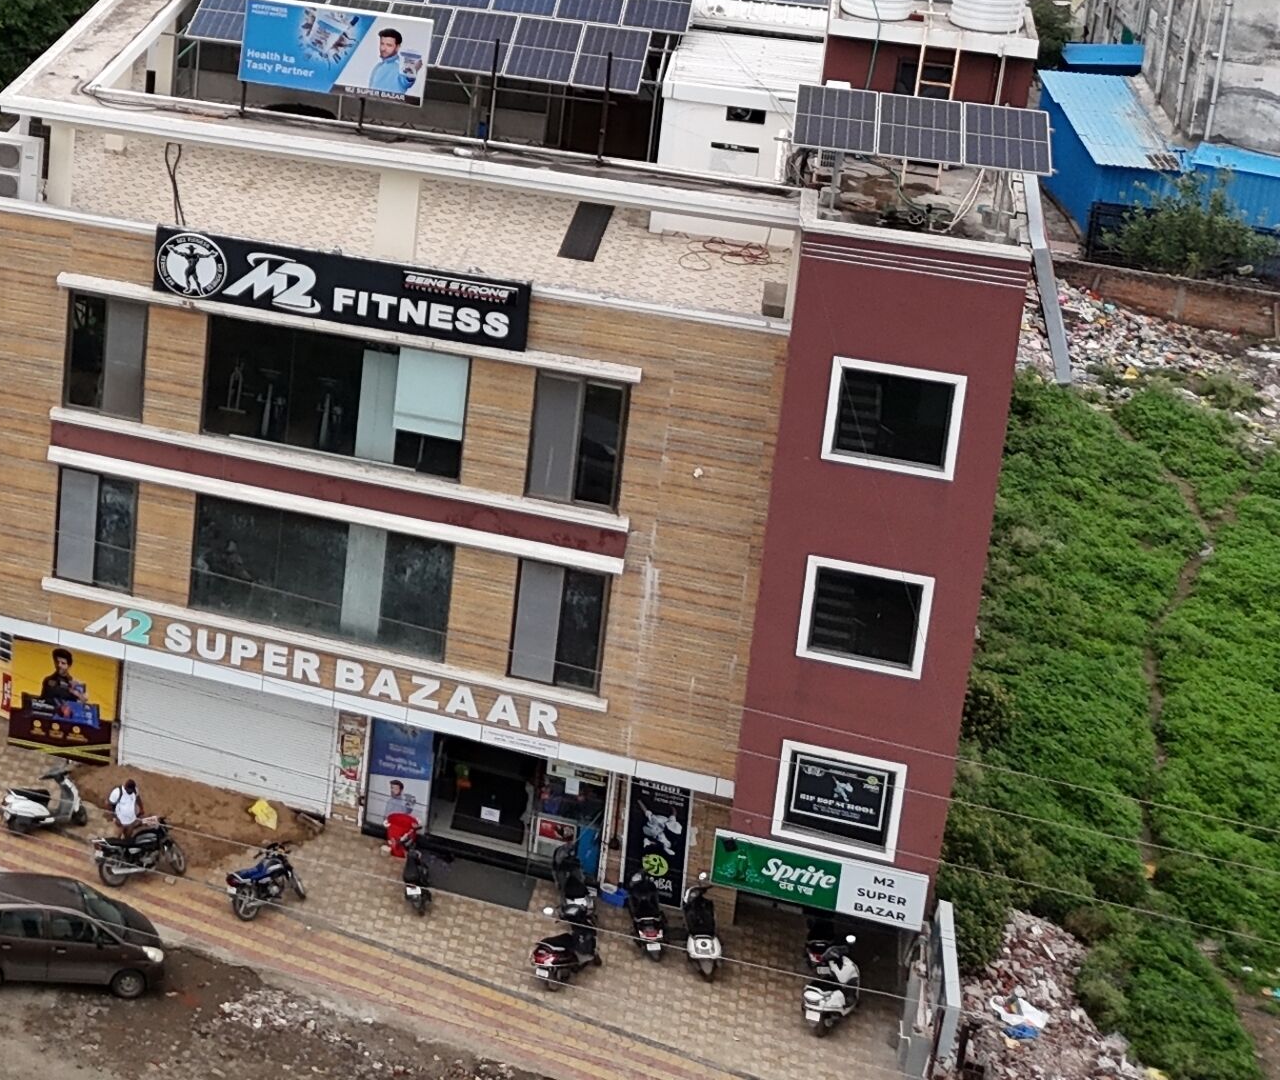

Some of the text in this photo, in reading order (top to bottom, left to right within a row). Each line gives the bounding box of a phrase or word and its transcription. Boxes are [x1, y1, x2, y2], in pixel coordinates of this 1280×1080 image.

[247, 48, 296, 64] Health ka
[246, 59, 315, 77] Tasty Partner
[356, 87, 379, 97] SUPER
[405, 274, 510, 298] BEING STRONG
[222, 256, 510, 338] M2 FITNESS
[84, 607, 559, 737] M2 SUPER BAZAAR
[761, 858, 836, 889] Sprite
[873, 876, 895, 889] M2
[857, 887, 907, 907] SUPER
[853, 902, 907, 922] BAZAR
